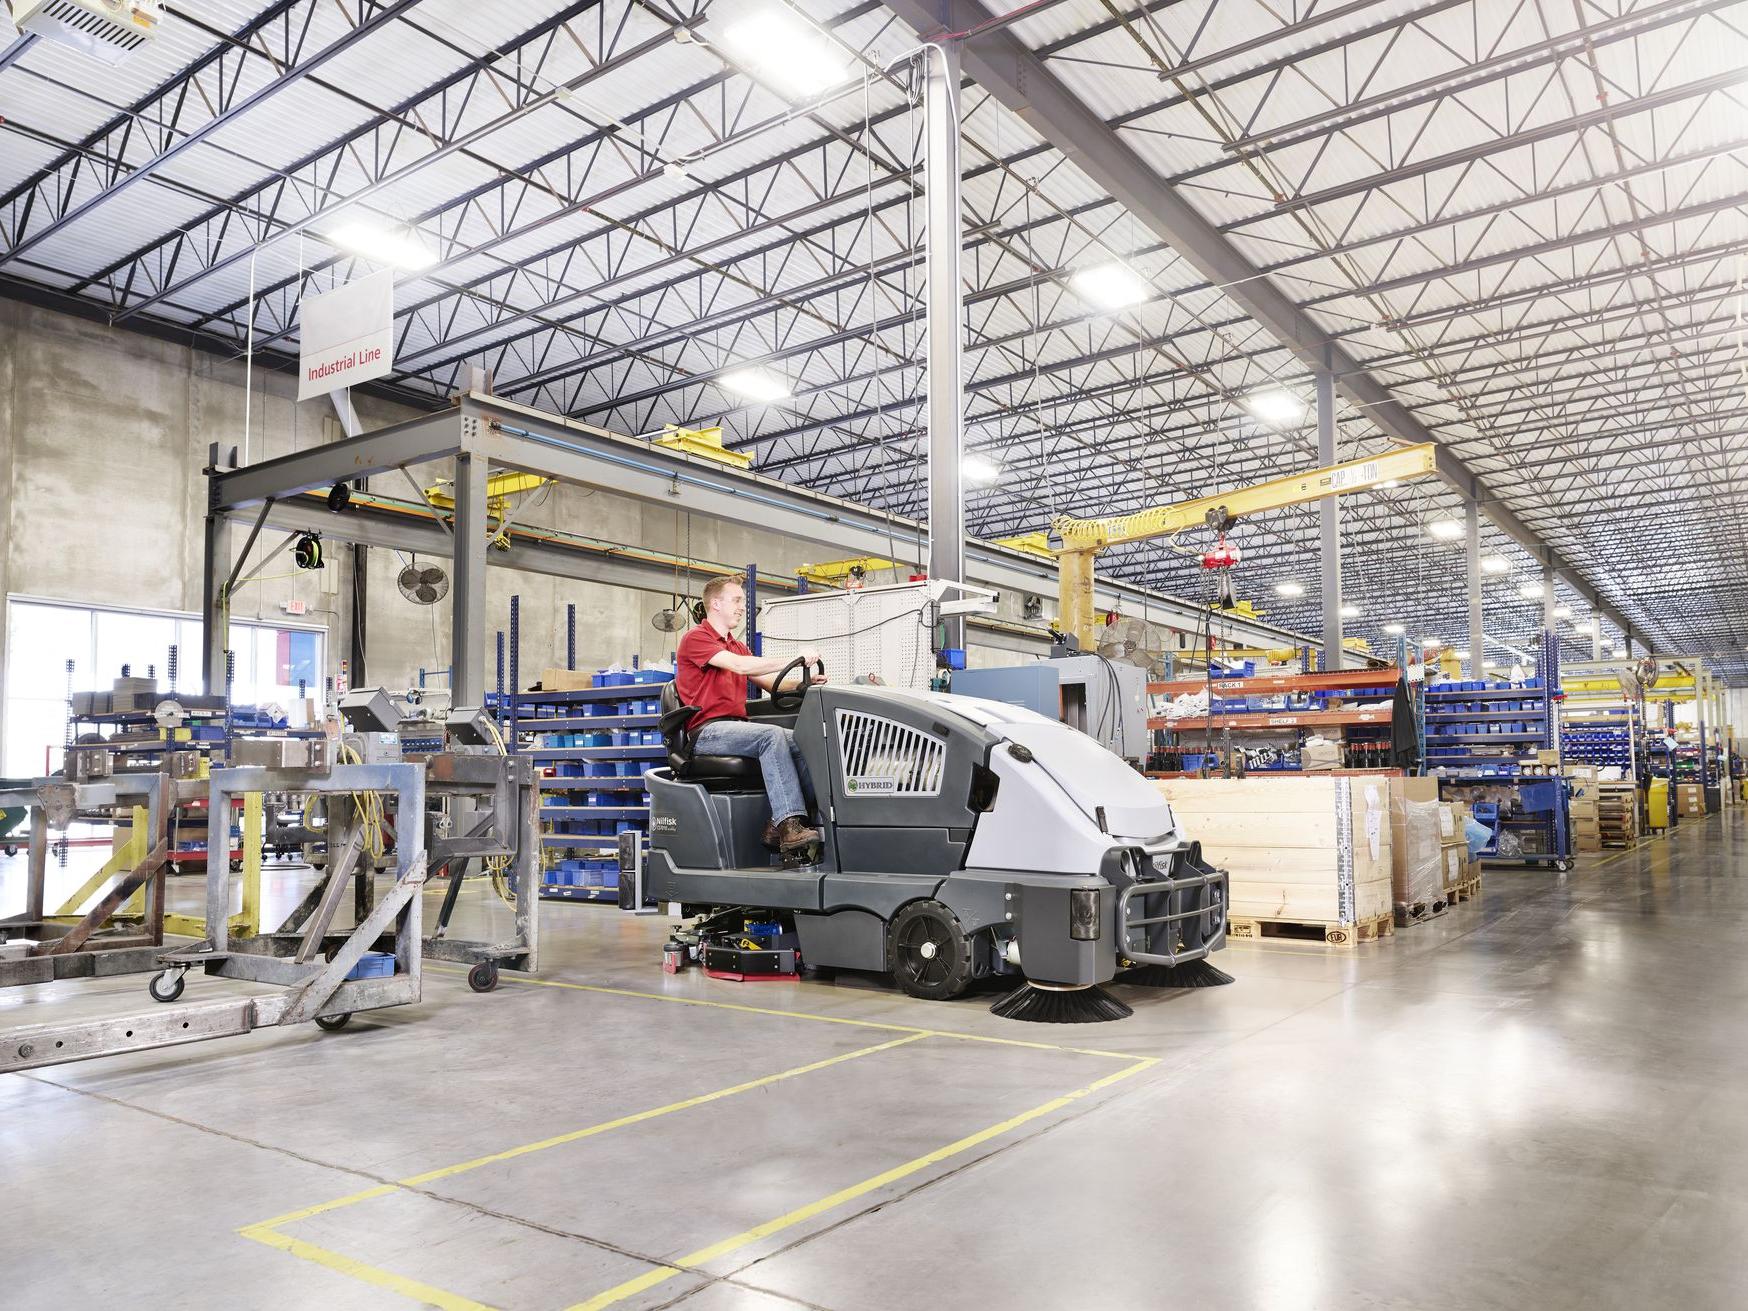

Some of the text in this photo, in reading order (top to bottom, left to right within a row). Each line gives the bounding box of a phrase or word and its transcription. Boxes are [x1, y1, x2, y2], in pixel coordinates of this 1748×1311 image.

[308, 348, 381, 381] Industrial Line
[656, 817, 677, 826] Nilfisk
